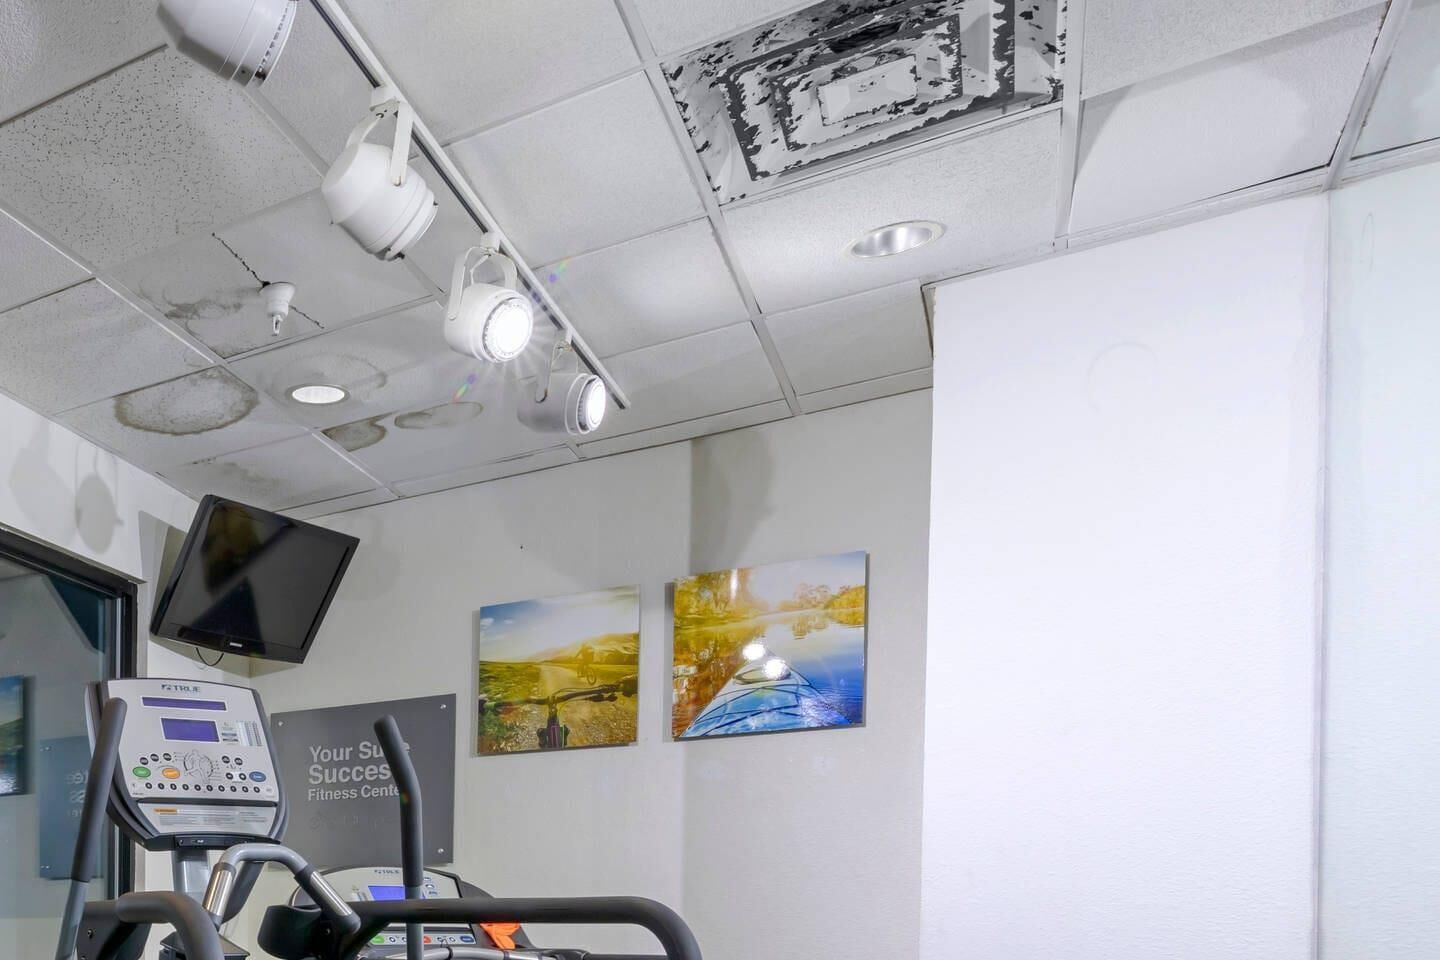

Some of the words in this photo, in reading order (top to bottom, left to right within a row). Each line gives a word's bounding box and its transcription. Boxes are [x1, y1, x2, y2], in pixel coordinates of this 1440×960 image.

[309, 745, 353, 763] Your
[358, 740, 410, 760] Sue
[308, 763, 392, 785] Succes
[307, 787, 358, 801] Fitness
[361, 783, 400, 798] Cente
